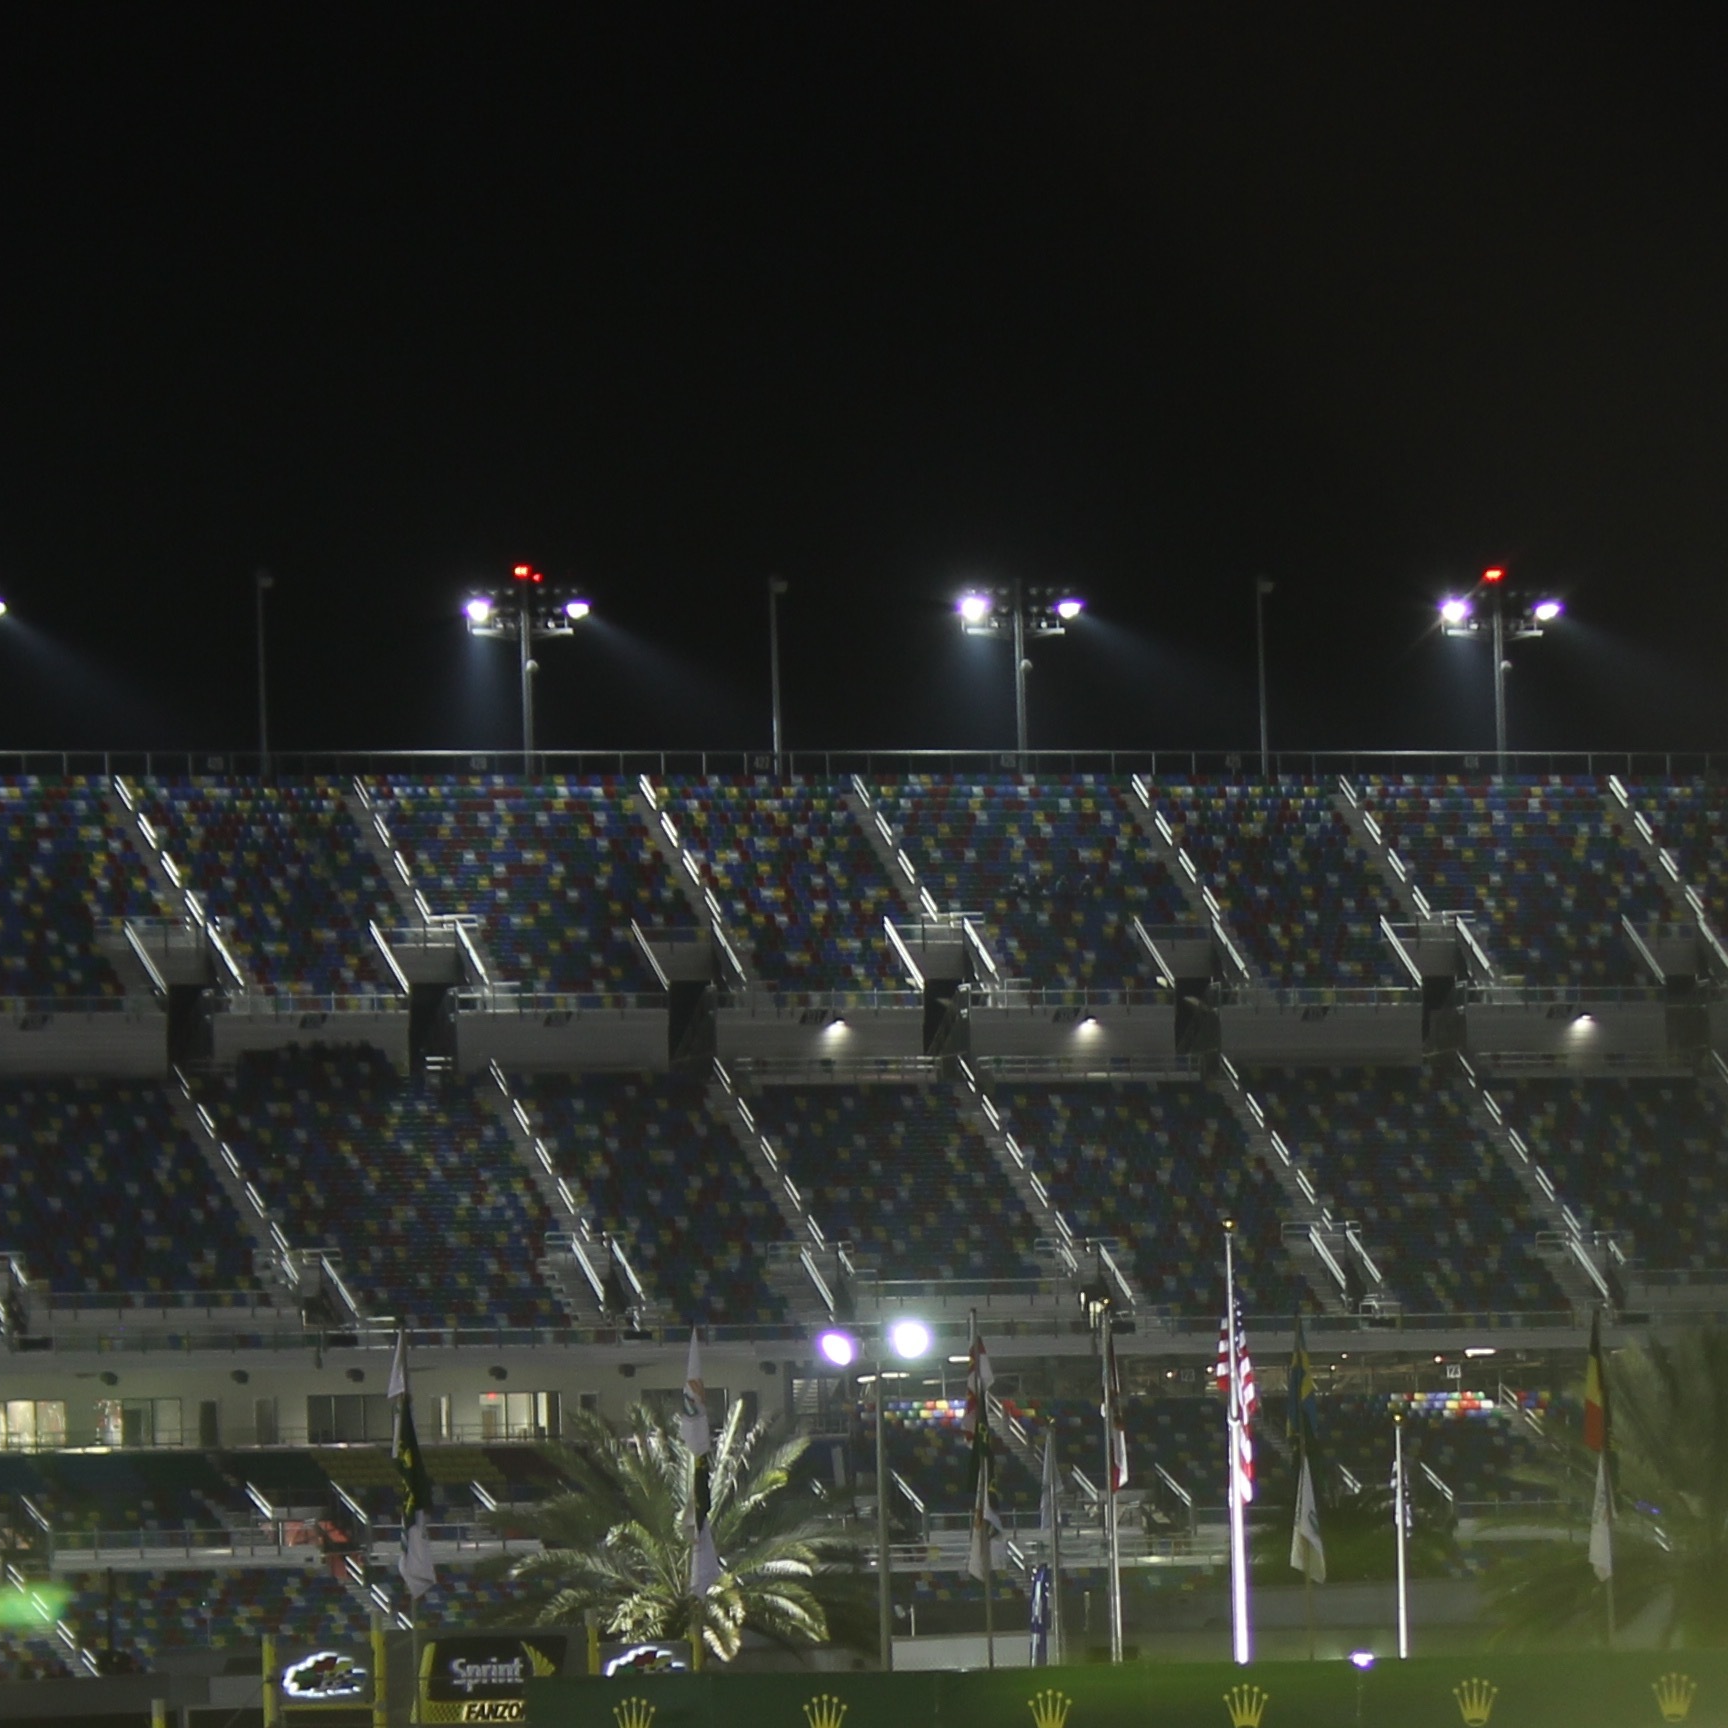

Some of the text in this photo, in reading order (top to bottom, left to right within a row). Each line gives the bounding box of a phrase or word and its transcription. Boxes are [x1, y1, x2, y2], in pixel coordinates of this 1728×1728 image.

[1446, 1364, 1462, 1379] 123
[451, 1657, 525, 1692] Sprint
[464, 1702, 525, 1722] FANZO
